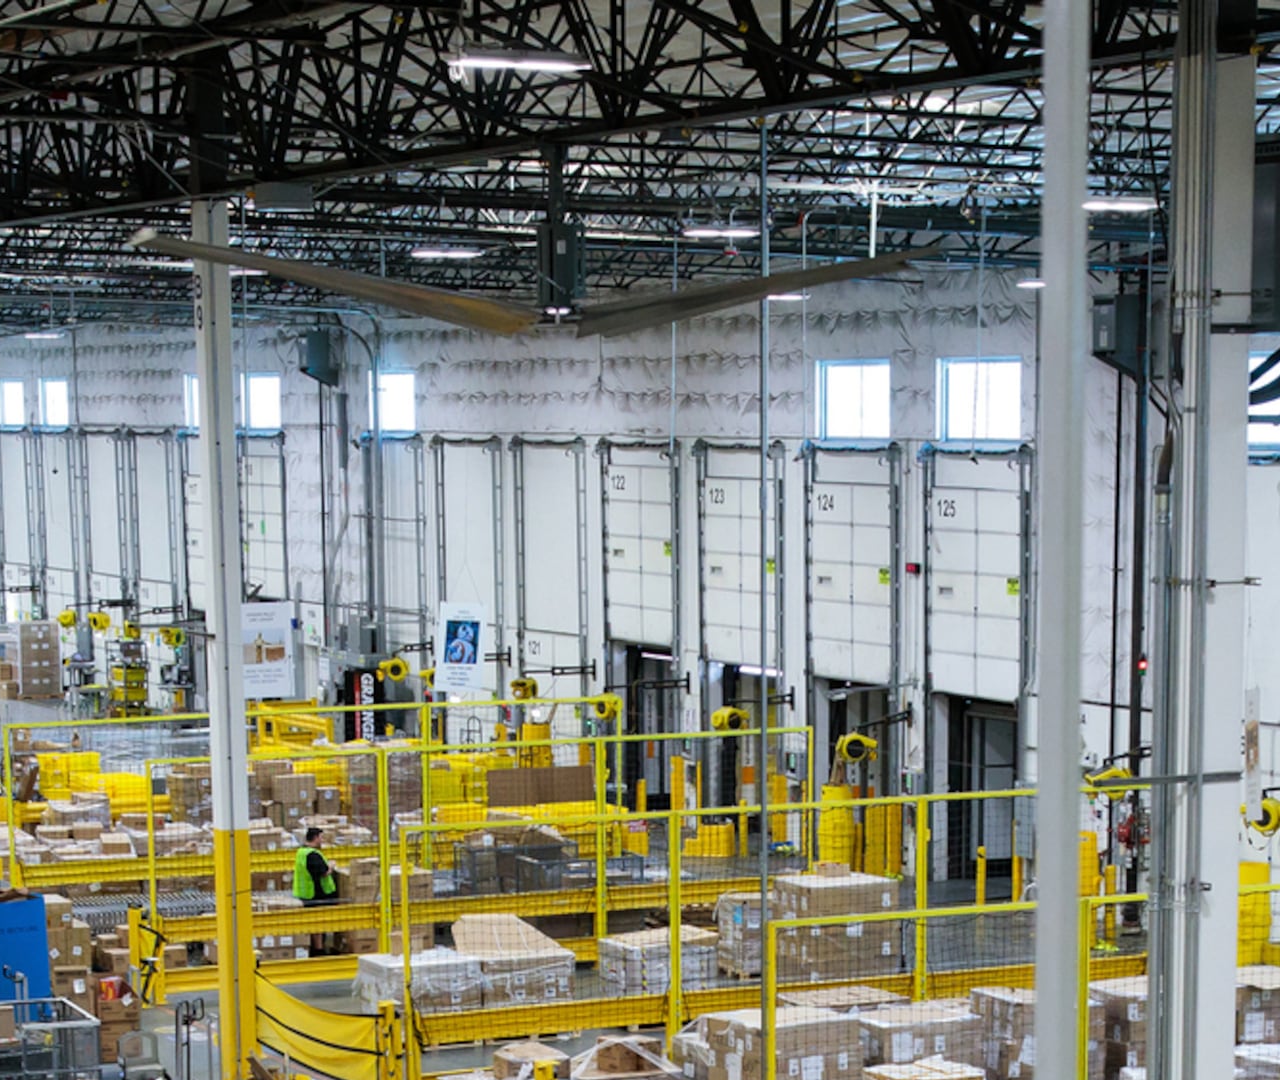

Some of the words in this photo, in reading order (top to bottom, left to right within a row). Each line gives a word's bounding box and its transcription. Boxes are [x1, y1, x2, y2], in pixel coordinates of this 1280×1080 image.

[611, 475, 625, 490] 122
[709, 488, 725, 504] 123
[817, 494, 834, 511] 124
[937, 499, 956, 517] 125
